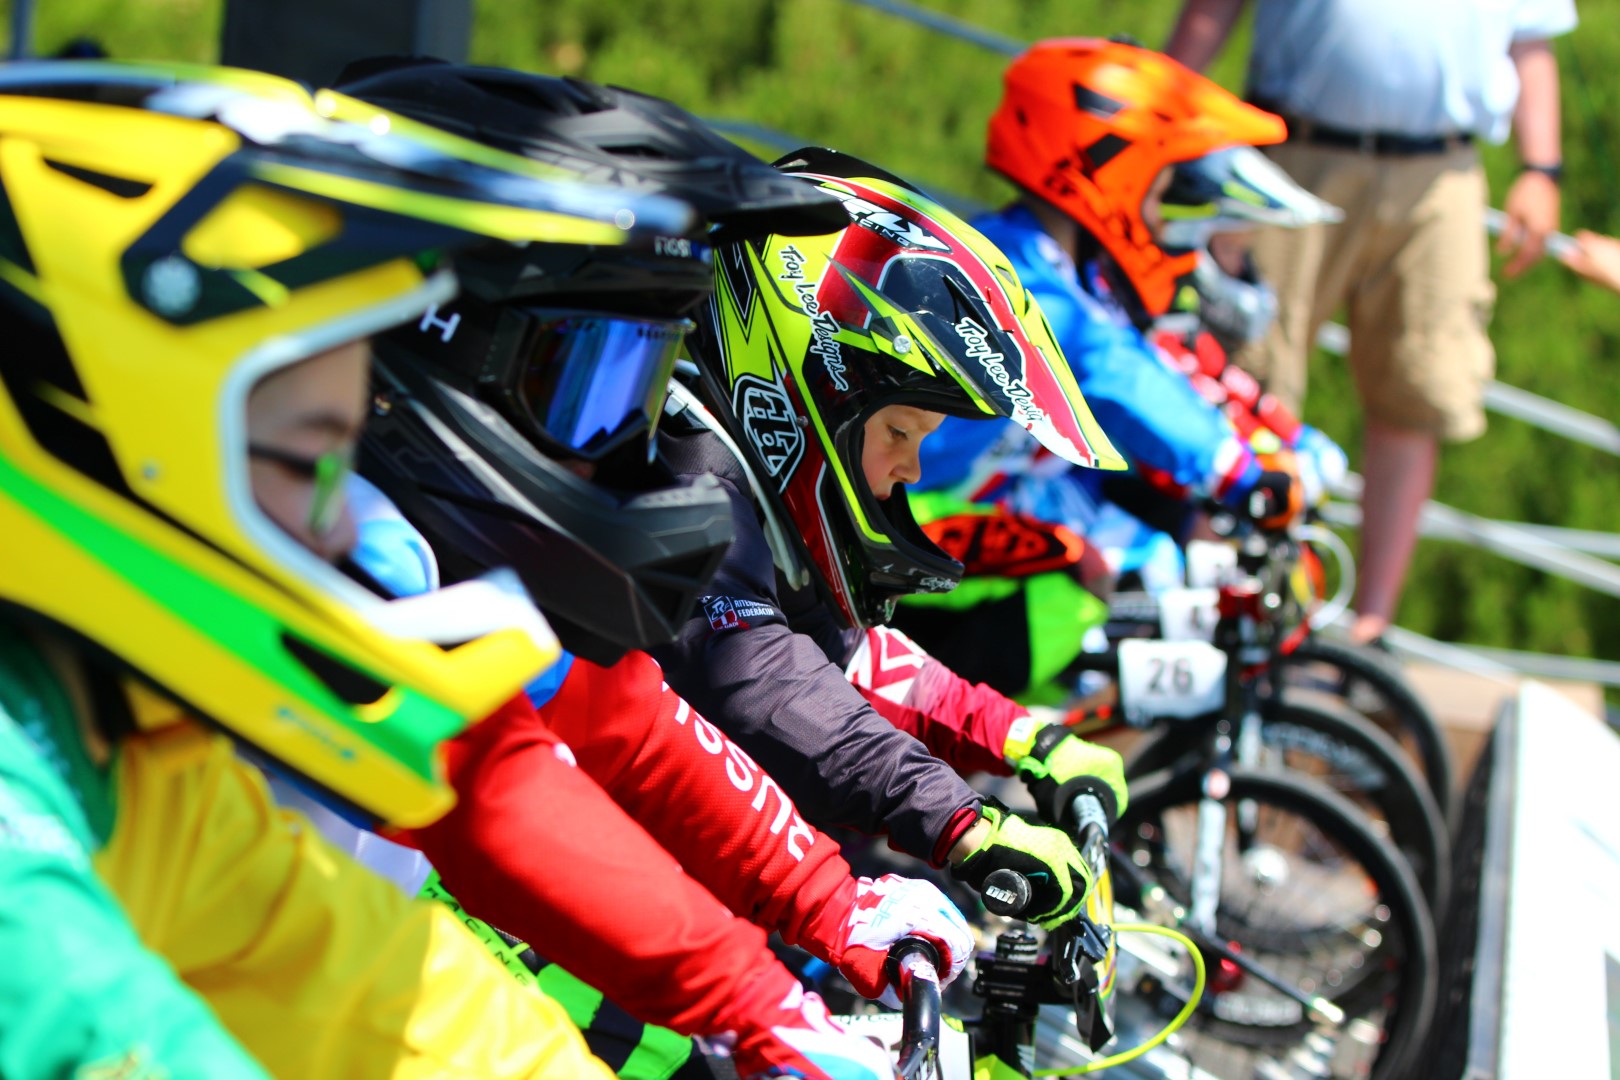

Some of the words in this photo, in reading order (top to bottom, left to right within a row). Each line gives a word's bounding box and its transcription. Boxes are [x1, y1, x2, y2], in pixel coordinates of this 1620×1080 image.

[780, 244, 806, 280] Troy
[796, 283, 819, 315] Lee
[811, 311, 848, 390] Designs
[956, 317, 991, 357] Troy
[979, 353, 1009, 386] Lee
[1147, 658, 1194, 694] 26
[661, 680, 815, 863] RUSSI
